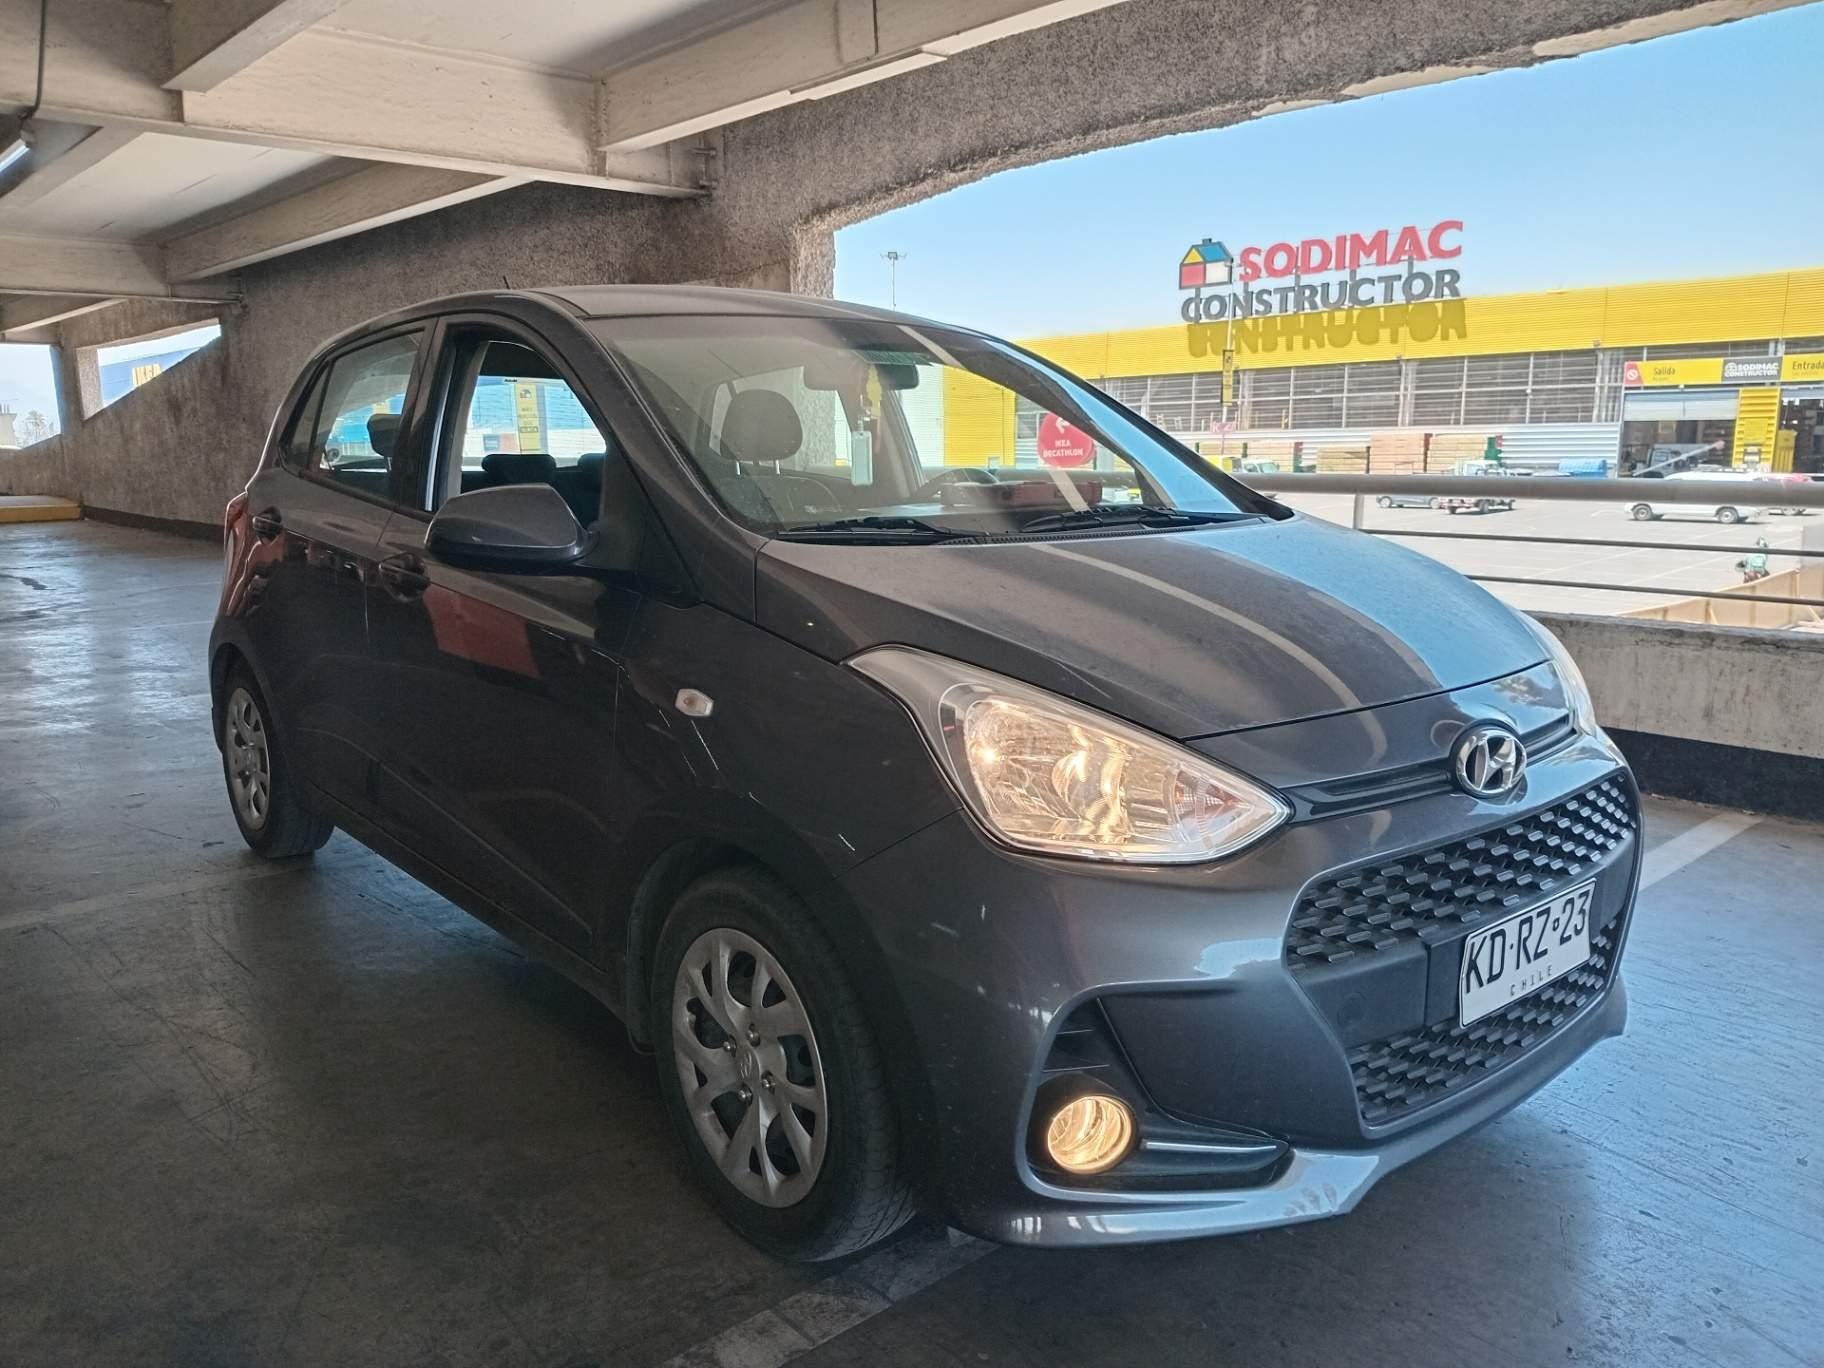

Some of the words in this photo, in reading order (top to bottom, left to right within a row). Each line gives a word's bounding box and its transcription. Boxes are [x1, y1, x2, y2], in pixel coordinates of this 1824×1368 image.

[1239, 220, 1464, 282] SODIMAC
[1181, 268, 1461, 323] CONSTRUCTOR
[1738, 362, 1779, 371] SODIMAC
[1043, 448, 1084, 458] DECATHLON
[1510, 964, 1553, 996] CHILE
